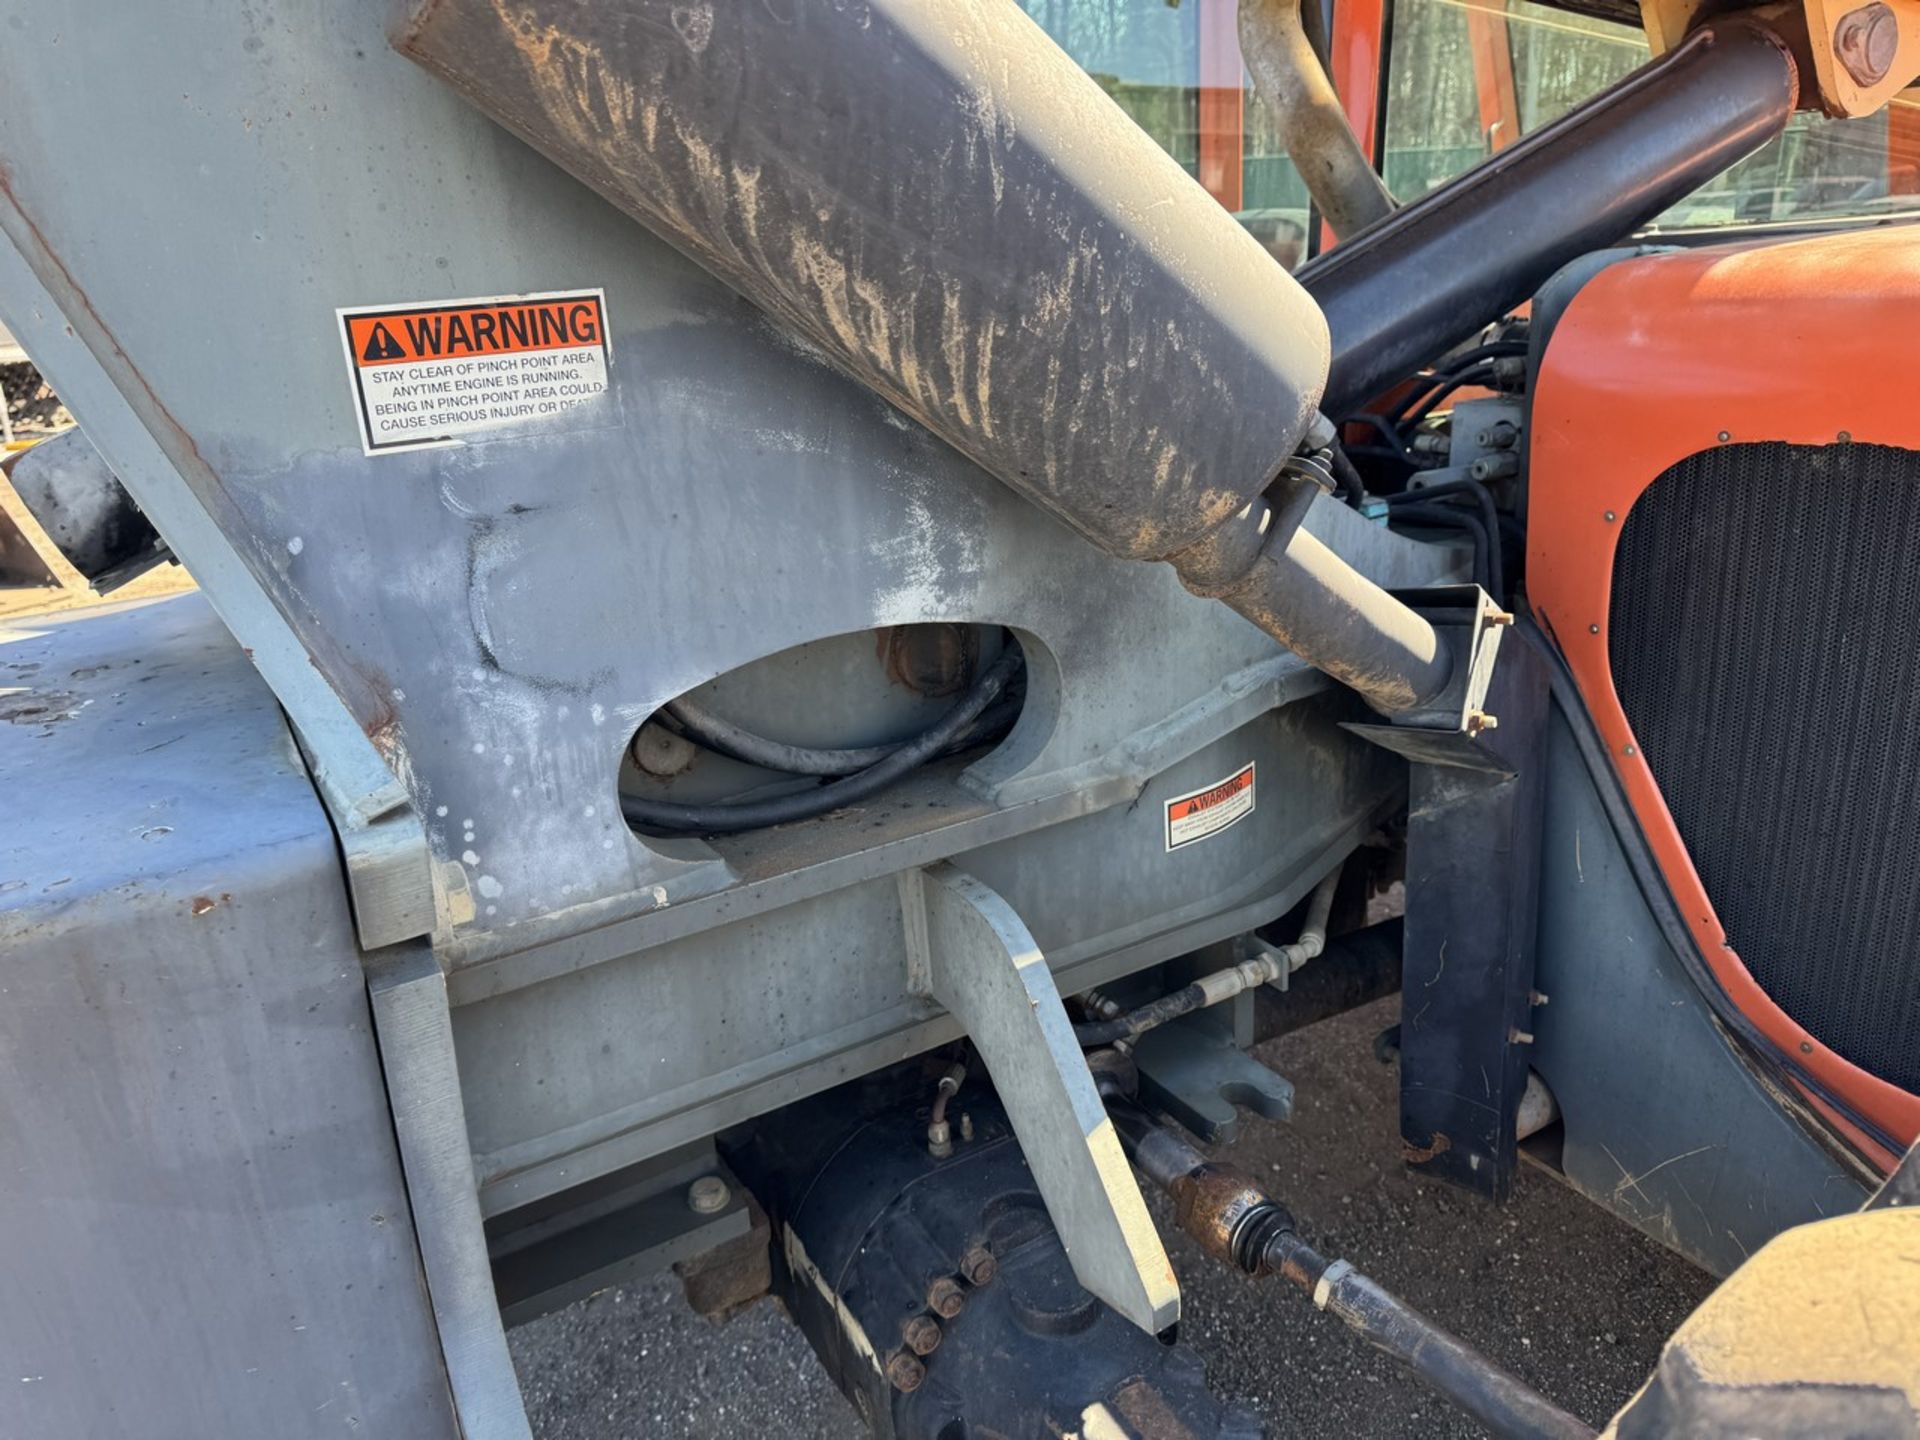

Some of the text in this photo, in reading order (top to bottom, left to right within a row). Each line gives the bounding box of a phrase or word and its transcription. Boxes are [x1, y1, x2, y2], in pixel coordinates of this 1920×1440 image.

[404, 304, 597, 357] WARNING
[372, 352, 596, 384] STAY CLEAR OF PINCH POINT AREA
[392, 368, 582, 398] ANYTIME ENGINE IS RUNNING.
[374, 382, 602, 416] BEING IN PINCH POINT AREA COULD
[381, 416, 428, 432] CAUSE
[429, 409, 487, 426] SERIOUS
[490, 403, 535, 419] INJURY
[538, 401, 557, 415] OR
[1199, 777, 1243, 810] WARNING
